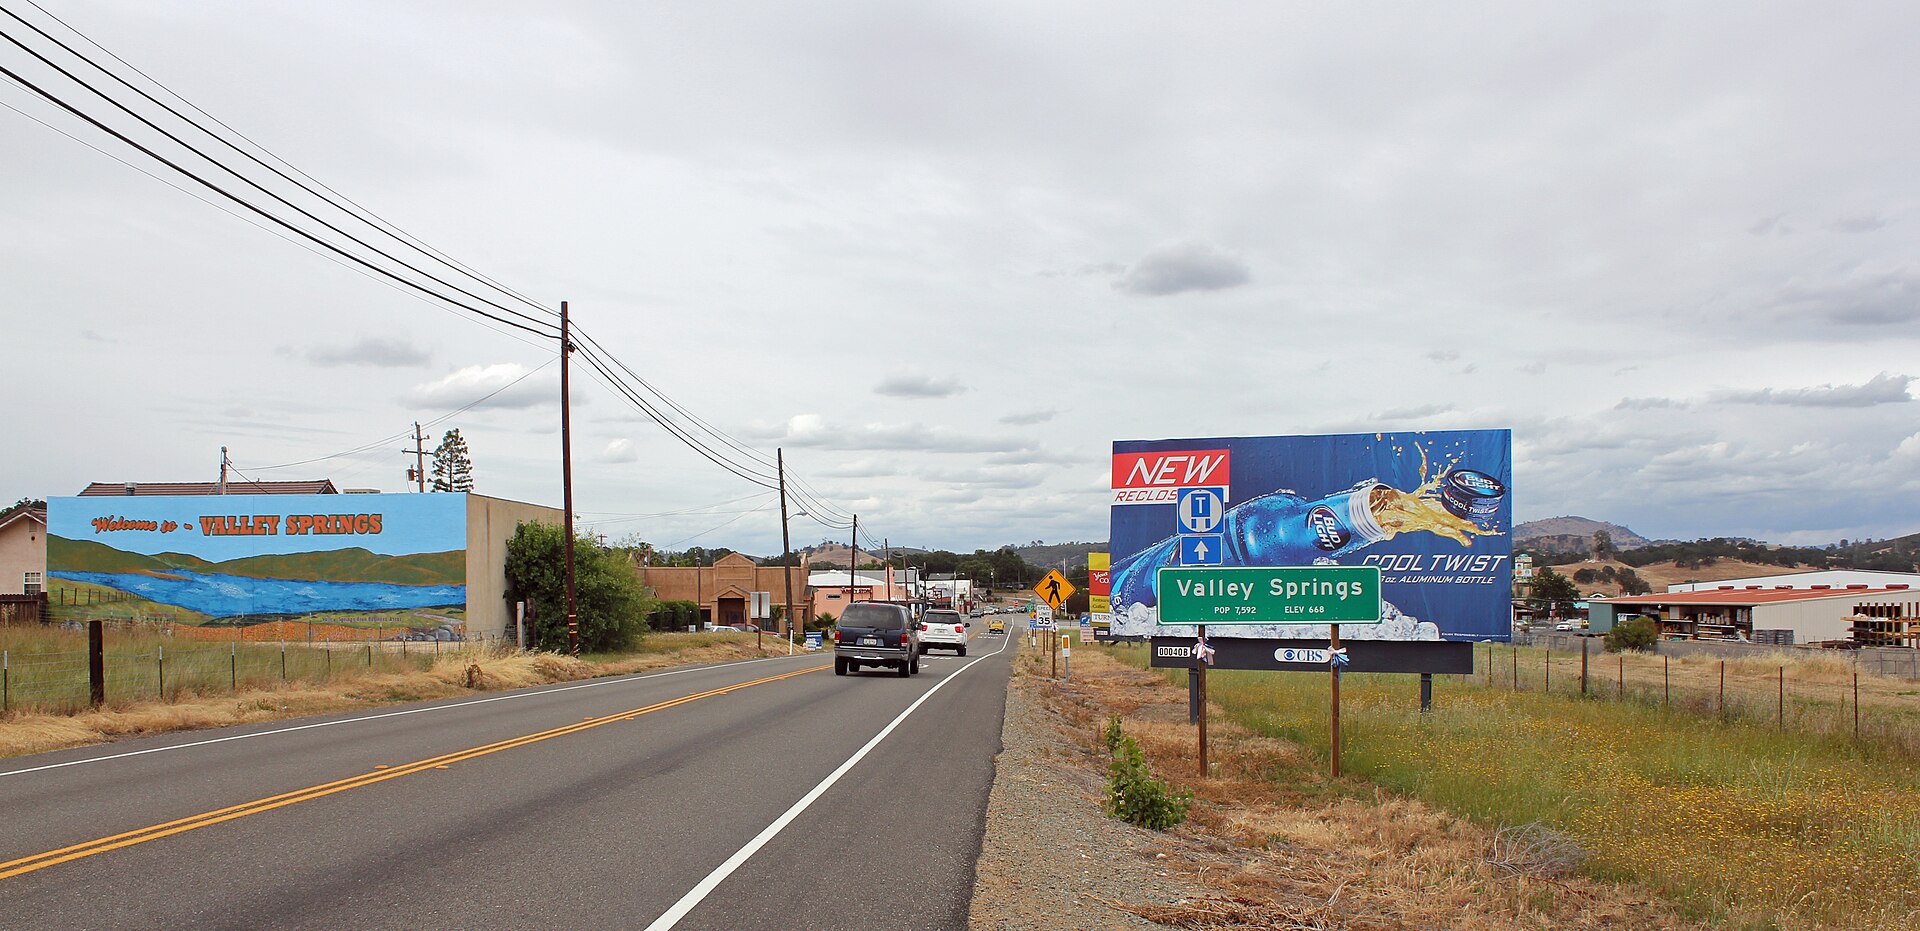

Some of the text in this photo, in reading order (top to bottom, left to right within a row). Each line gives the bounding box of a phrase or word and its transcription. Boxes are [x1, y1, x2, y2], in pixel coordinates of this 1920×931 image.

[1125, 454, 1225, 486] NEW
[91, 515, 158, 534] Welcome
[160, 519, 178, 533] to
[199, 515, 280, 536] VALLEY
[286, 514, 382, 535] SPRINGS
[1313, 513, 1335, 550] LIGHT
[1323, 516, 1341, 544] BUD
[1429, 554, 1508, 572] TWIST
[1176, 578, 1363, 600] Valley Springs
[1398, 575, 1455, 584] ALUMINUM
[1455, 576, 1496, 584] BOTTLE
[1214, 605, 1325, 615] POP 7,592 ELEV 668
[1038, 616, 1051, 625] 35
[1297, 652, 1323, 662] CBS
